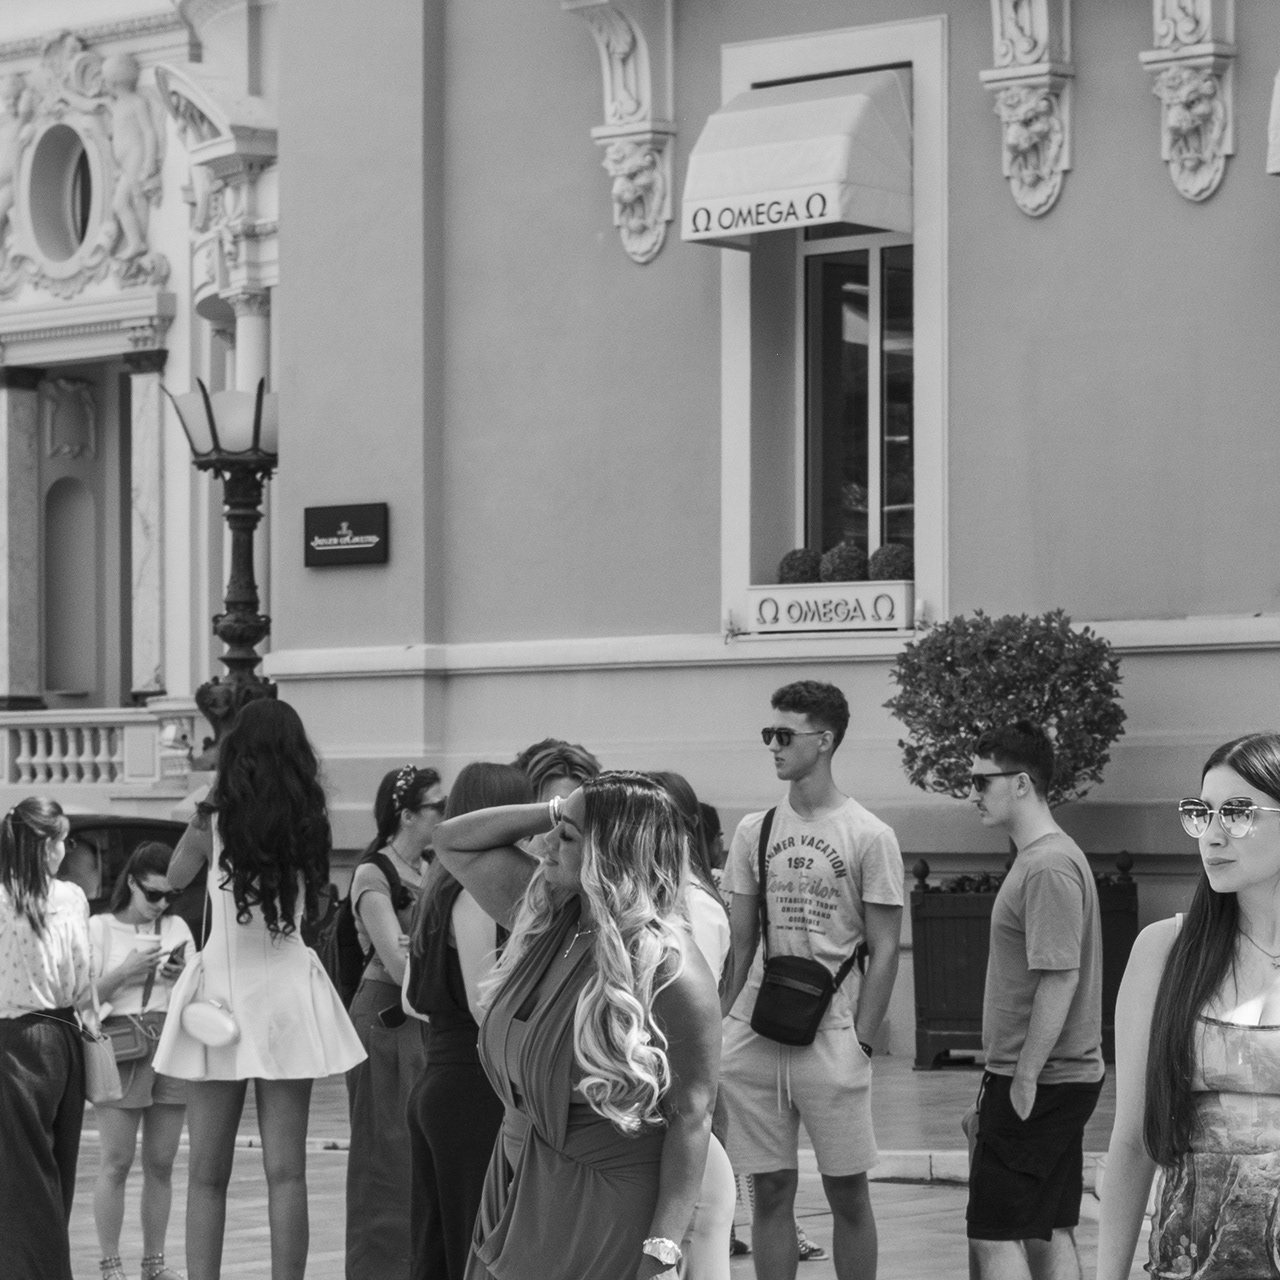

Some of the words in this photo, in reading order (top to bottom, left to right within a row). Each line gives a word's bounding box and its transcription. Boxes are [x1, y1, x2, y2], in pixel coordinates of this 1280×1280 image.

[717, 201, 800, 230] OMEGA
[787, 598, 867, 624] OMEGA
[787, 857, 814, 870] 1962
[800, 835, 847, 879] VACATION
